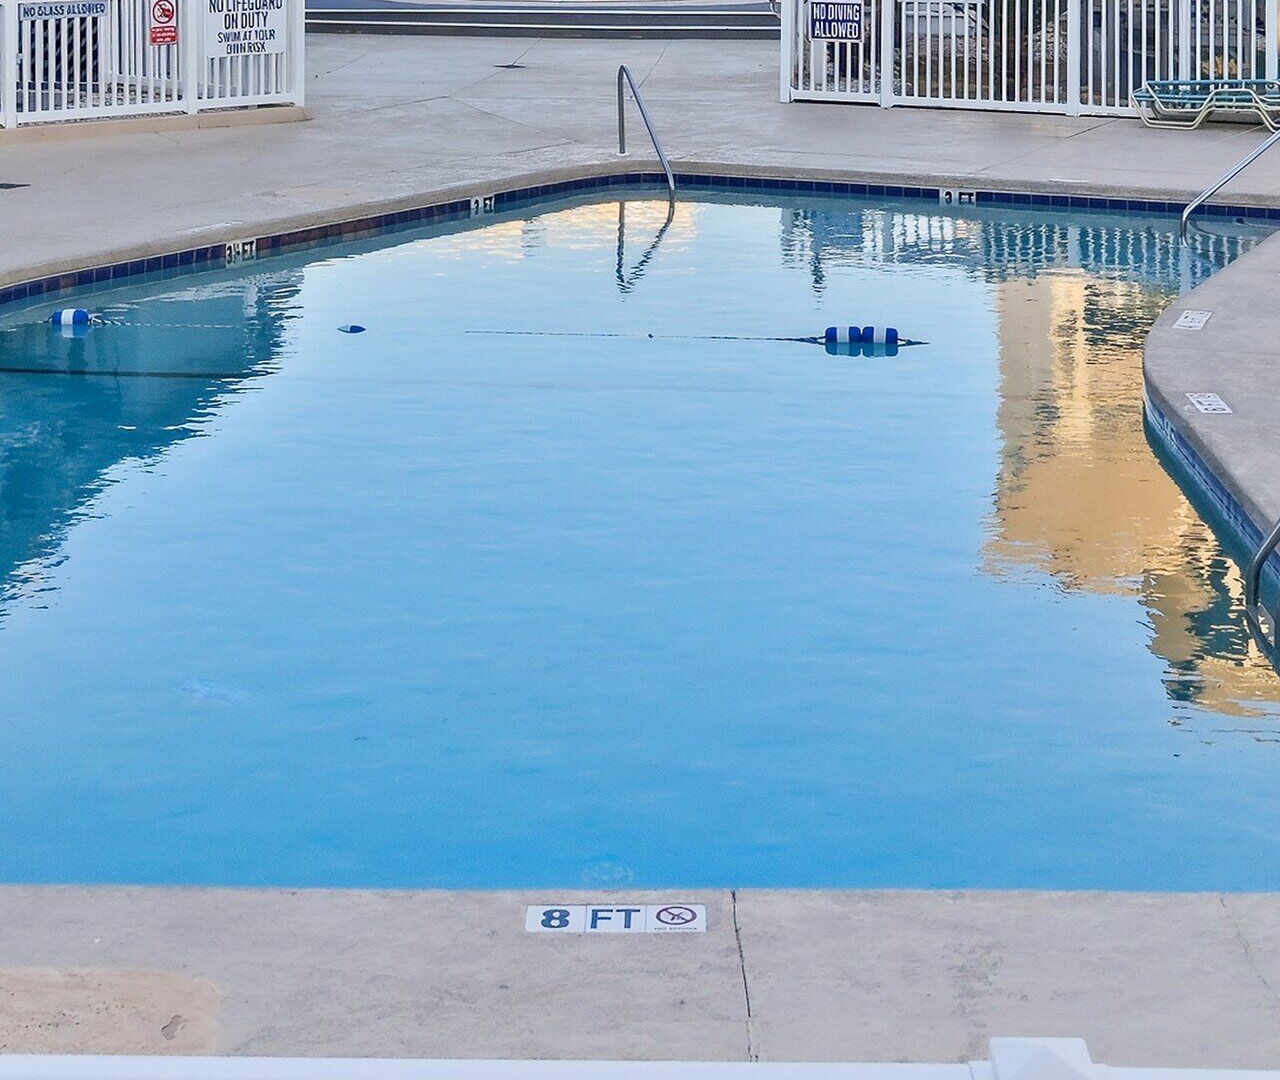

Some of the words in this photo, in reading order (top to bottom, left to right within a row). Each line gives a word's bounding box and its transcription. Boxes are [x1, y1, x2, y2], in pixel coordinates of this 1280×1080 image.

[23, 6, 36, 17] NO
[37, 4, 65, 16] GLASS
[66, 2, 106, 15] ALLOWED
[813, 4, 826, 20] NO
[828, 4, 860, 21] DIVING
[224, 13, 239, 30] ON
[240, 11, 269, 29] DUTY
[217, 31, 241, 44] SWIM
[242, 30, 253, 41] AT
[814, 21, 859, 38] ALLOWED
[226, 42, 246, 55] OWN
[247, 41, 267, 54] RISK
[540, 908, 571, 930] 8
[589, 908, 642, 930] FT
